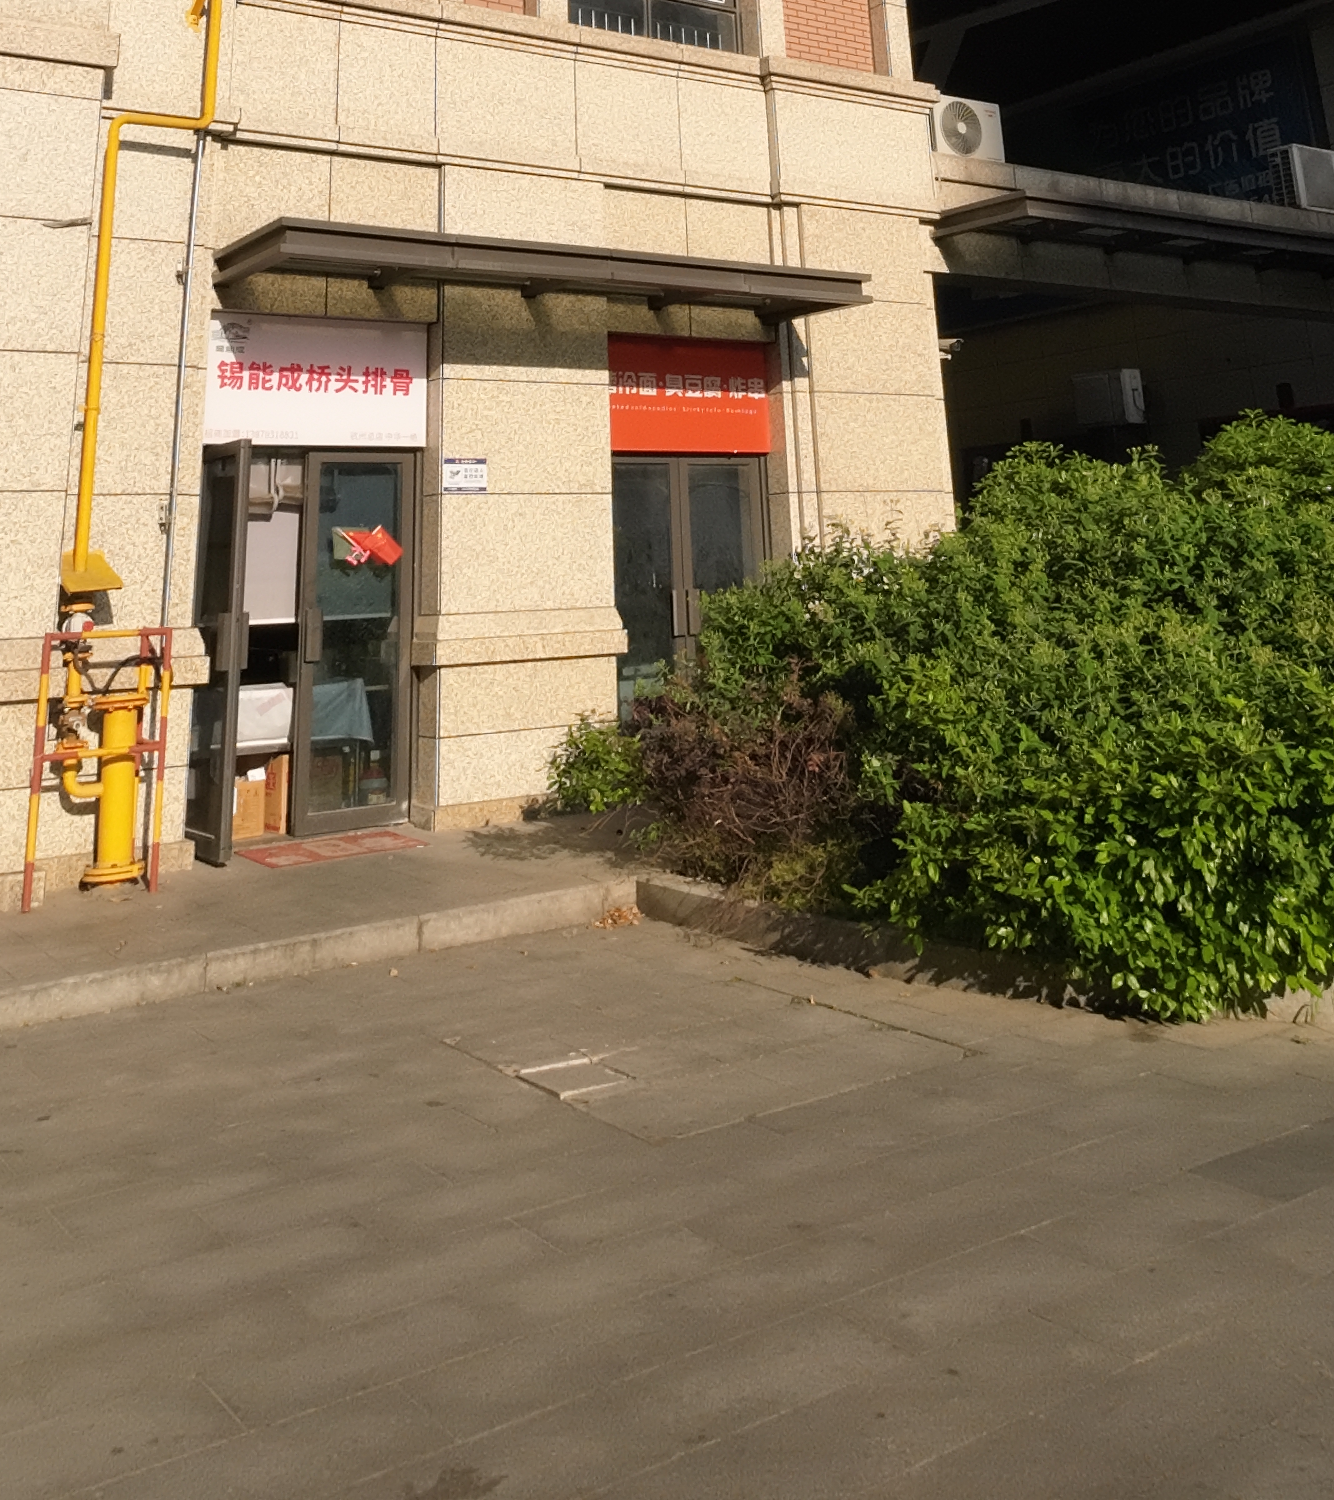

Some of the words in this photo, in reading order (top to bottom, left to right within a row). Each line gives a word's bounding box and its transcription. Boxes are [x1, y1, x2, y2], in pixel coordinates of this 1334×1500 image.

[217, 360, 414, 397] 锡能成桥头排骨
